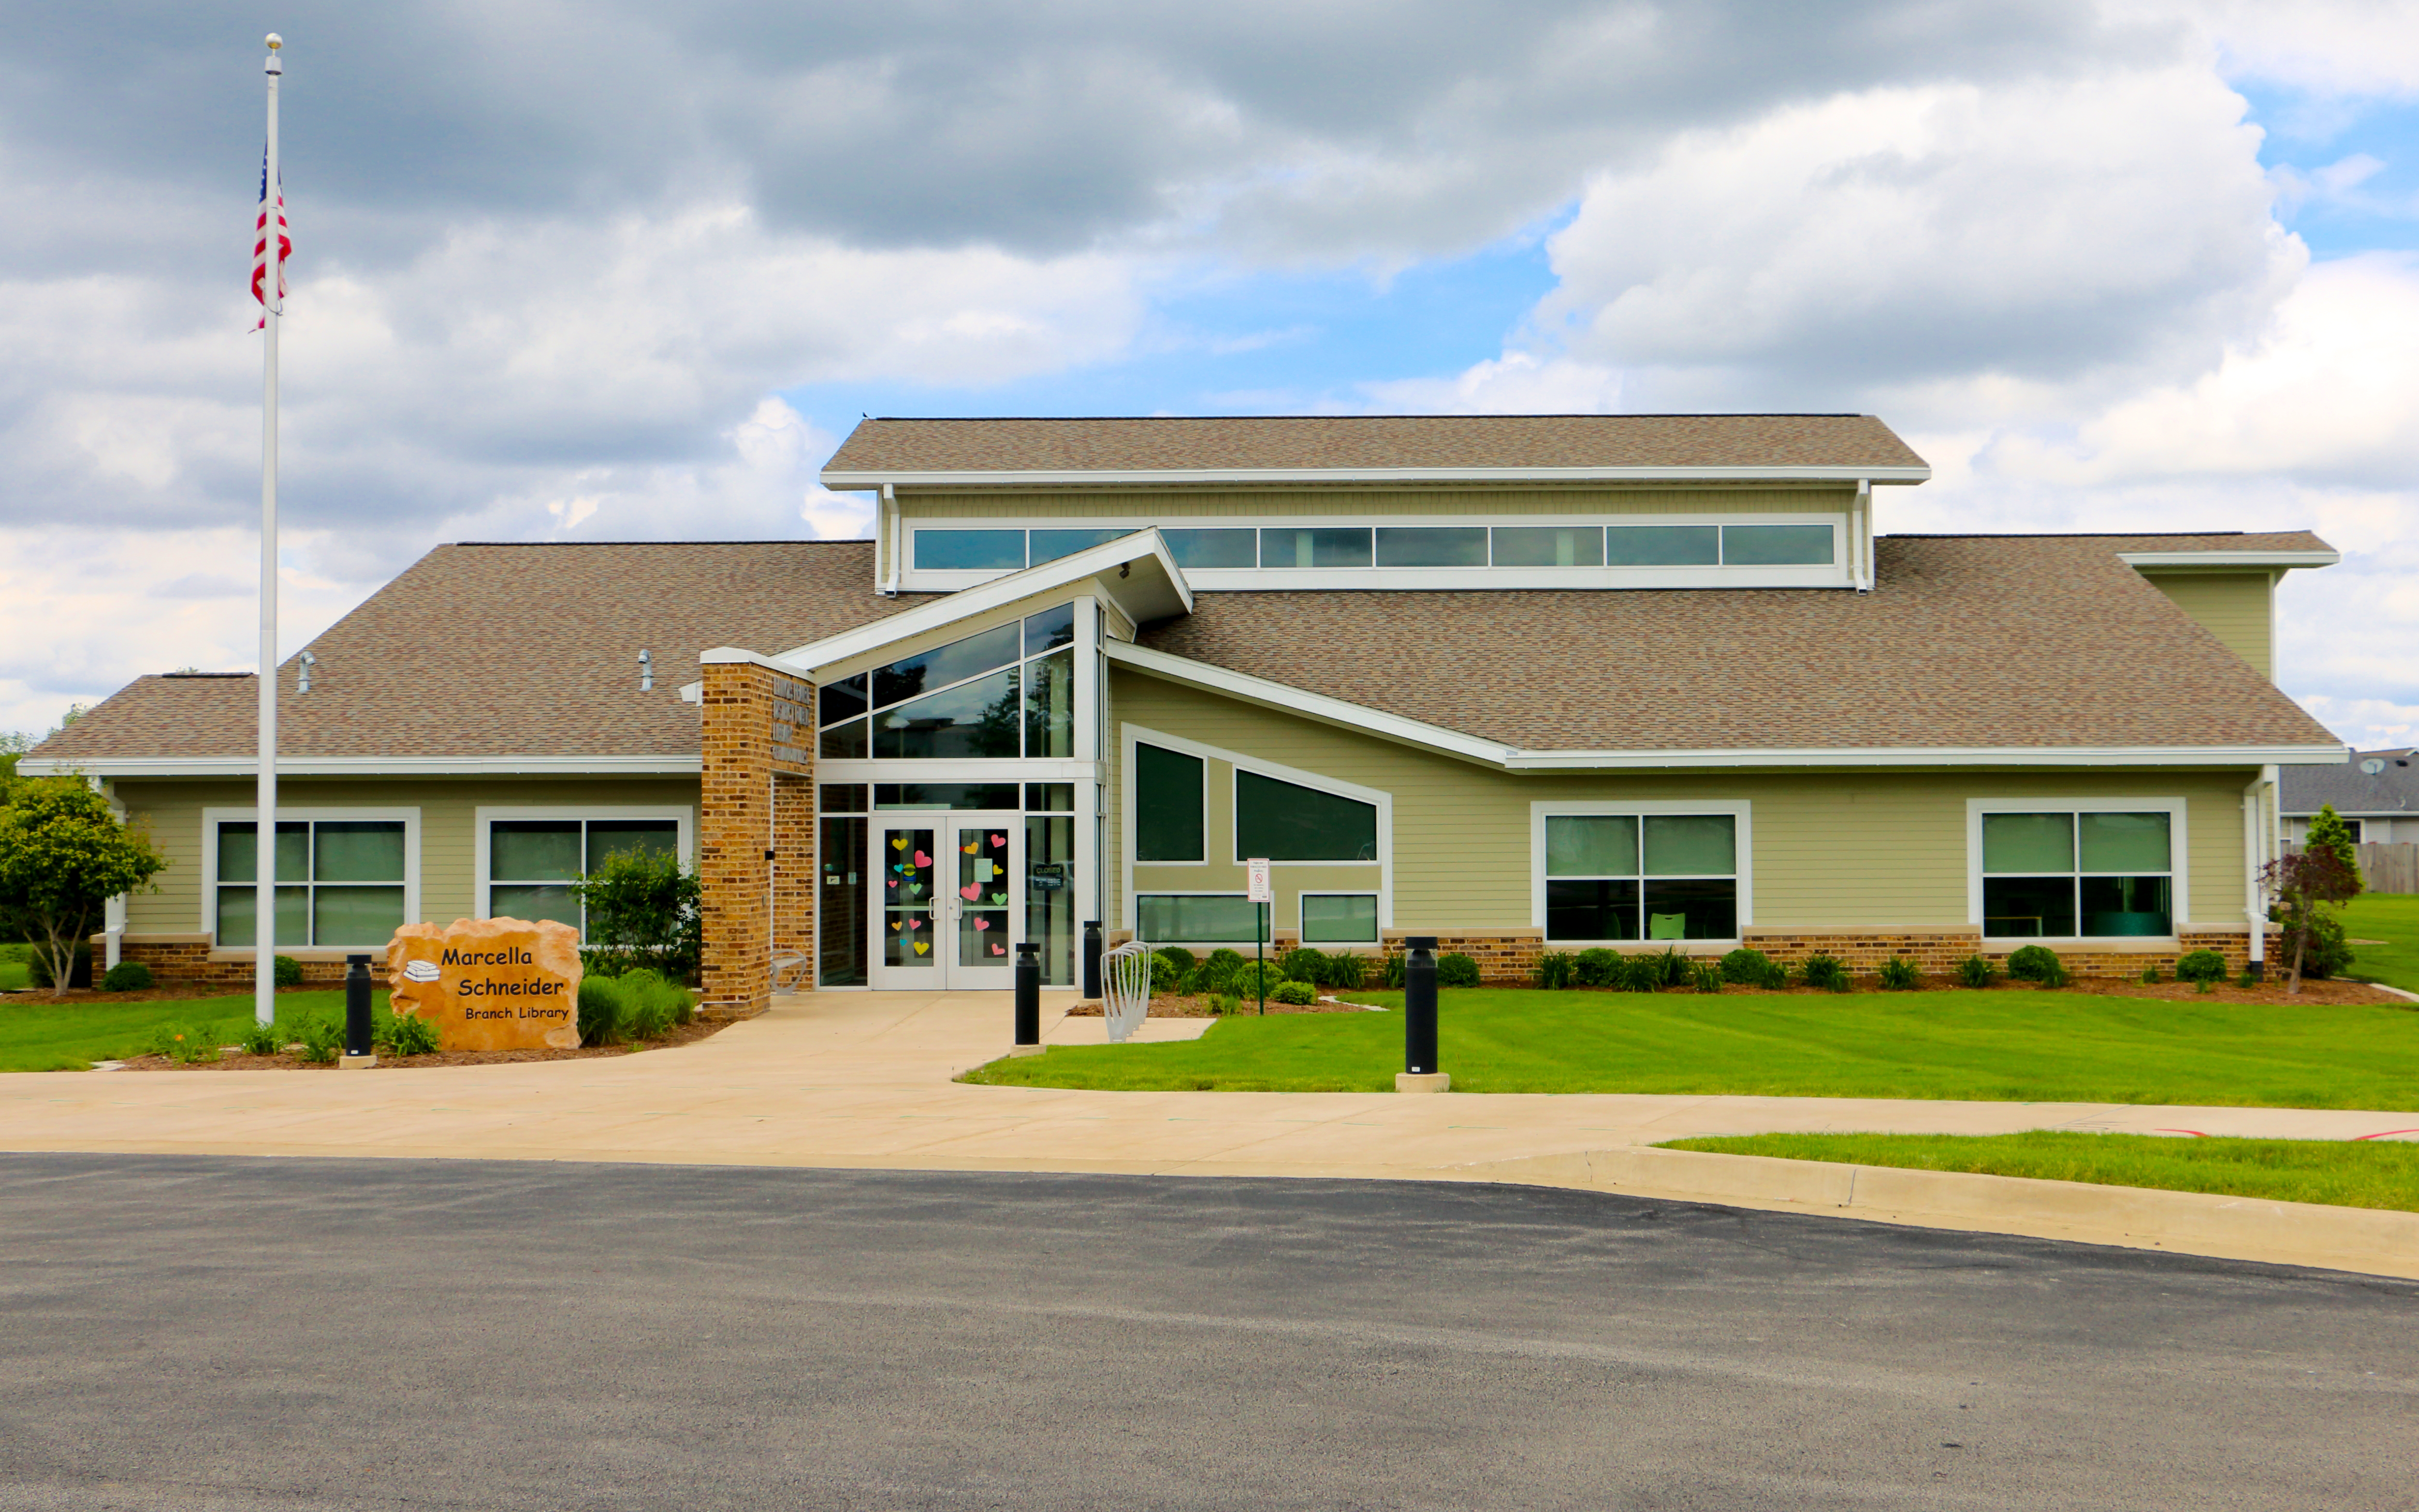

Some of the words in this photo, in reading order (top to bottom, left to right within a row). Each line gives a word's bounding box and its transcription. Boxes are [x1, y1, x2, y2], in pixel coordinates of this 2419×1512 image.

[441, 946, 532, 966] Marcella
[458, 977, 564, 997] Schneider
[466, 1007, 512, 1020] Branch
[519, 1006, 569, 1021] Library
